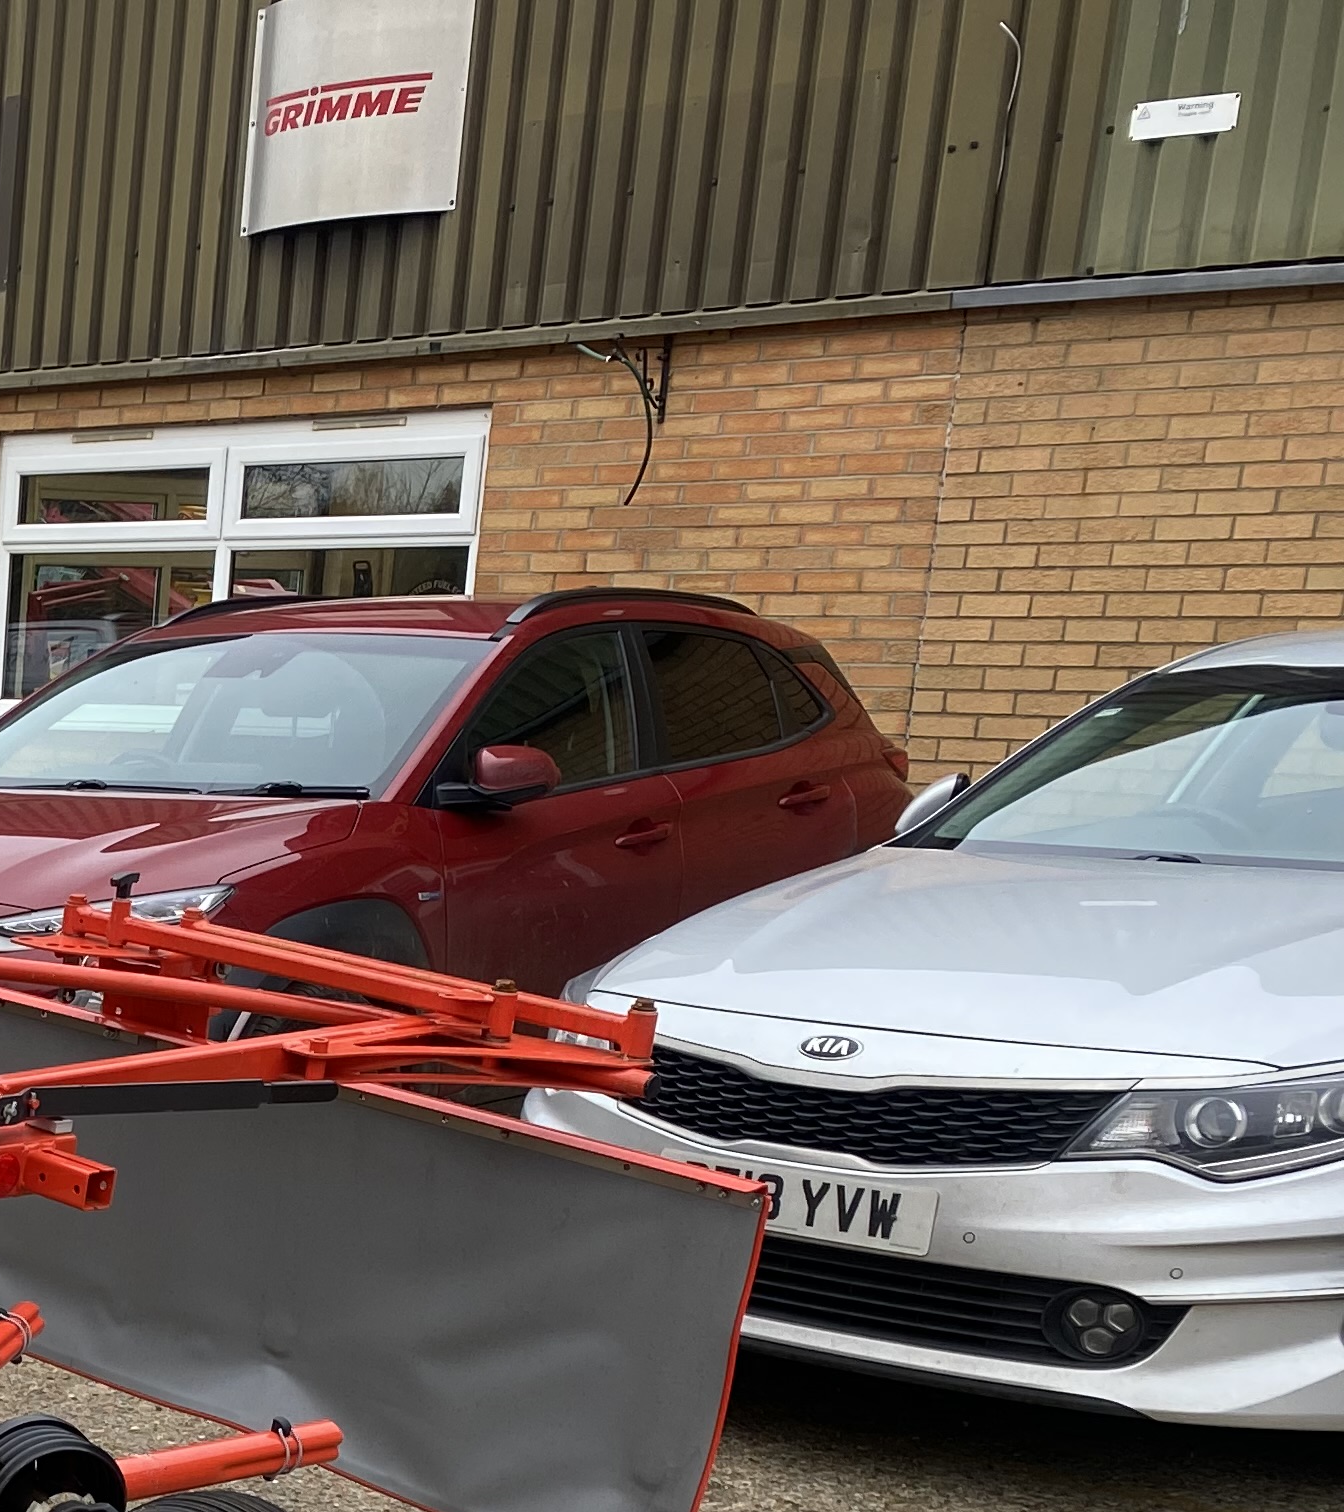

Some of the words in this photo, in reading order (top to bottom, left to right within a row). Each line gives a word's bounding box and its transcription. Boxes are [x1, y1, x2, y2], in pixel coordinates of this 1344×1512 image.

[264, 85, 426, 137] GRIMME
[805, 1037, 850, 1056] KIA
[802, 1178, 902, 1240] YVW
